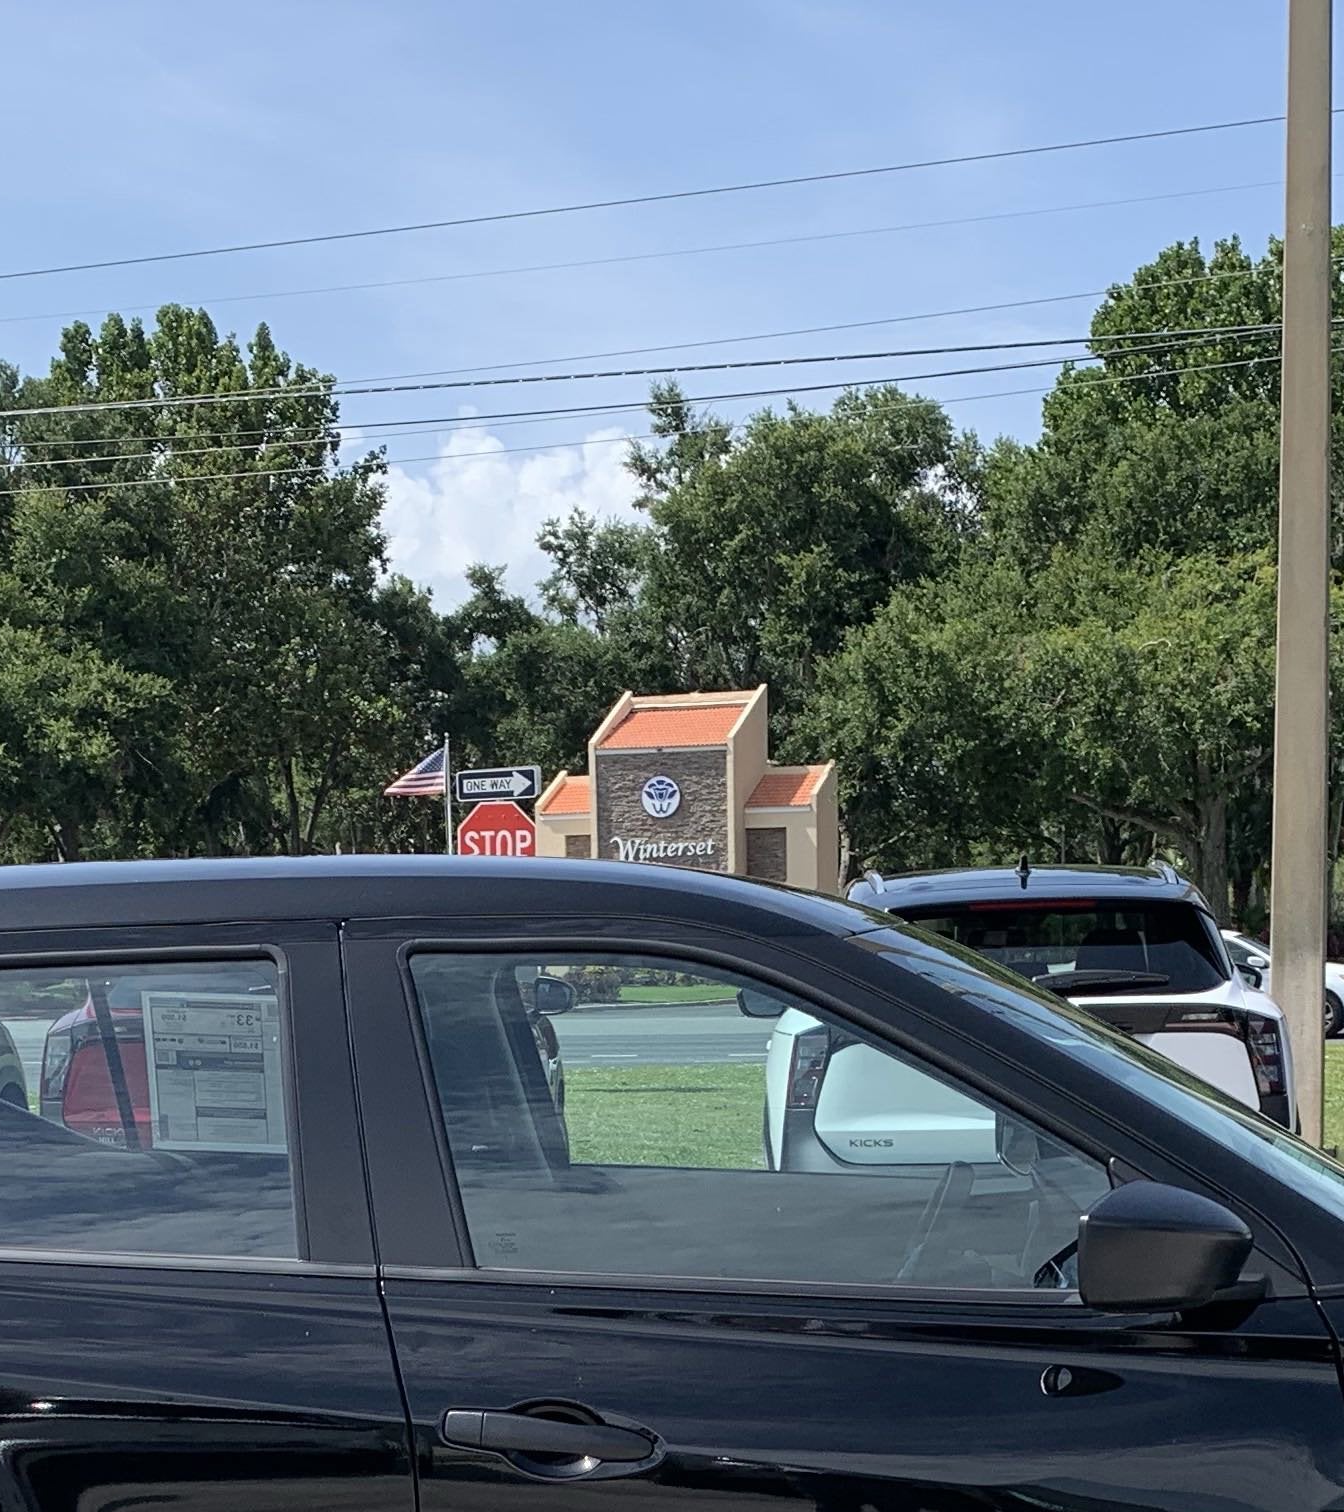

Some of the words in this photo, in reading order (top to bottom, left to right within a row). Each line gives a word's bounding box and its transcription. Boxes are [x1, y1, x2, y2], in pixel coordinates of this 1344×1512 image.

[466, 780, 487, 792] ONE
[490, 779, 511, 790] WAY
[464, 829, 532, 857] STOP
[610, 836, 715, 862] Winterset
[849, 1139, 894, 1148] KICKS
